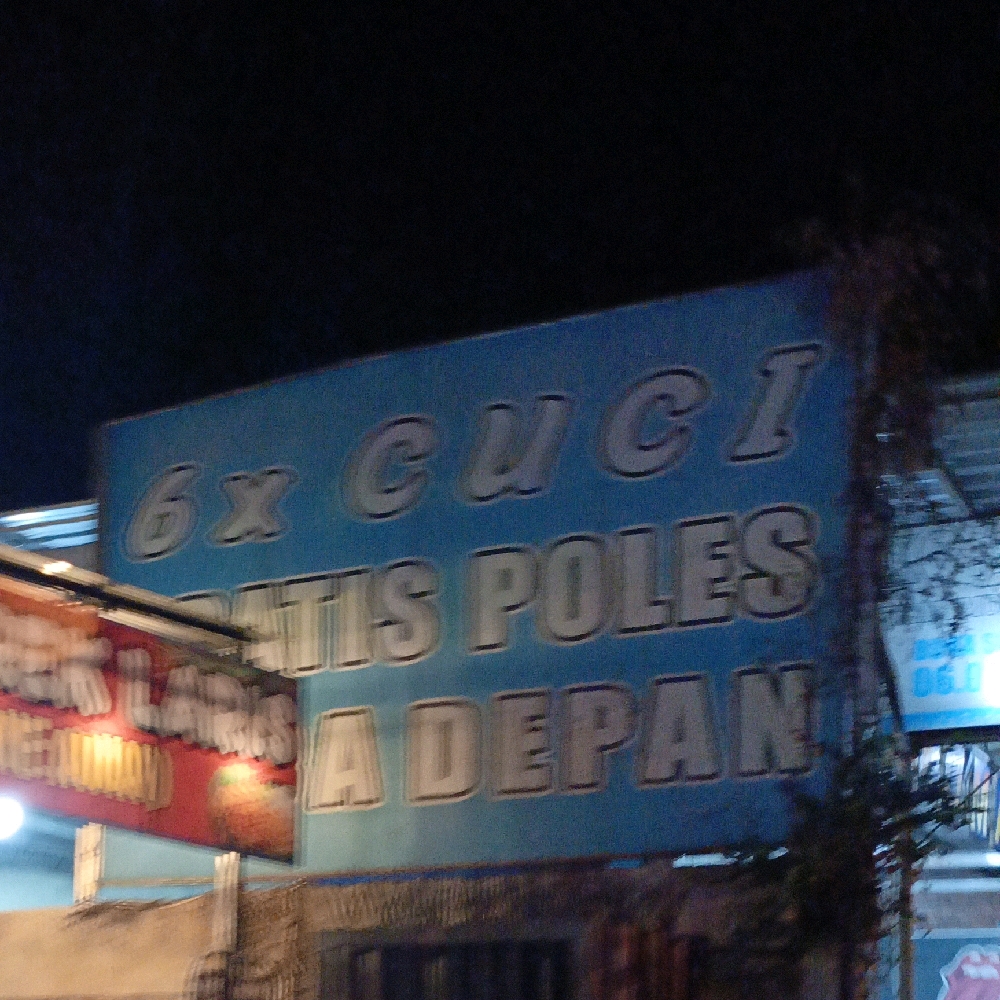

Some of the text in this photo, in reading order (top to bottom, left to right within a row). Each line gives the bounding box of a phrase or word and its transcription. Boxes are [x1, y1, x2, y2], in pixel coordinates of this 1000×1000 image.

[343, 342, 825, 521] CUCI
[468, 504, 820, 655] POLES
[406, 661, 816, 803] DEPAN
